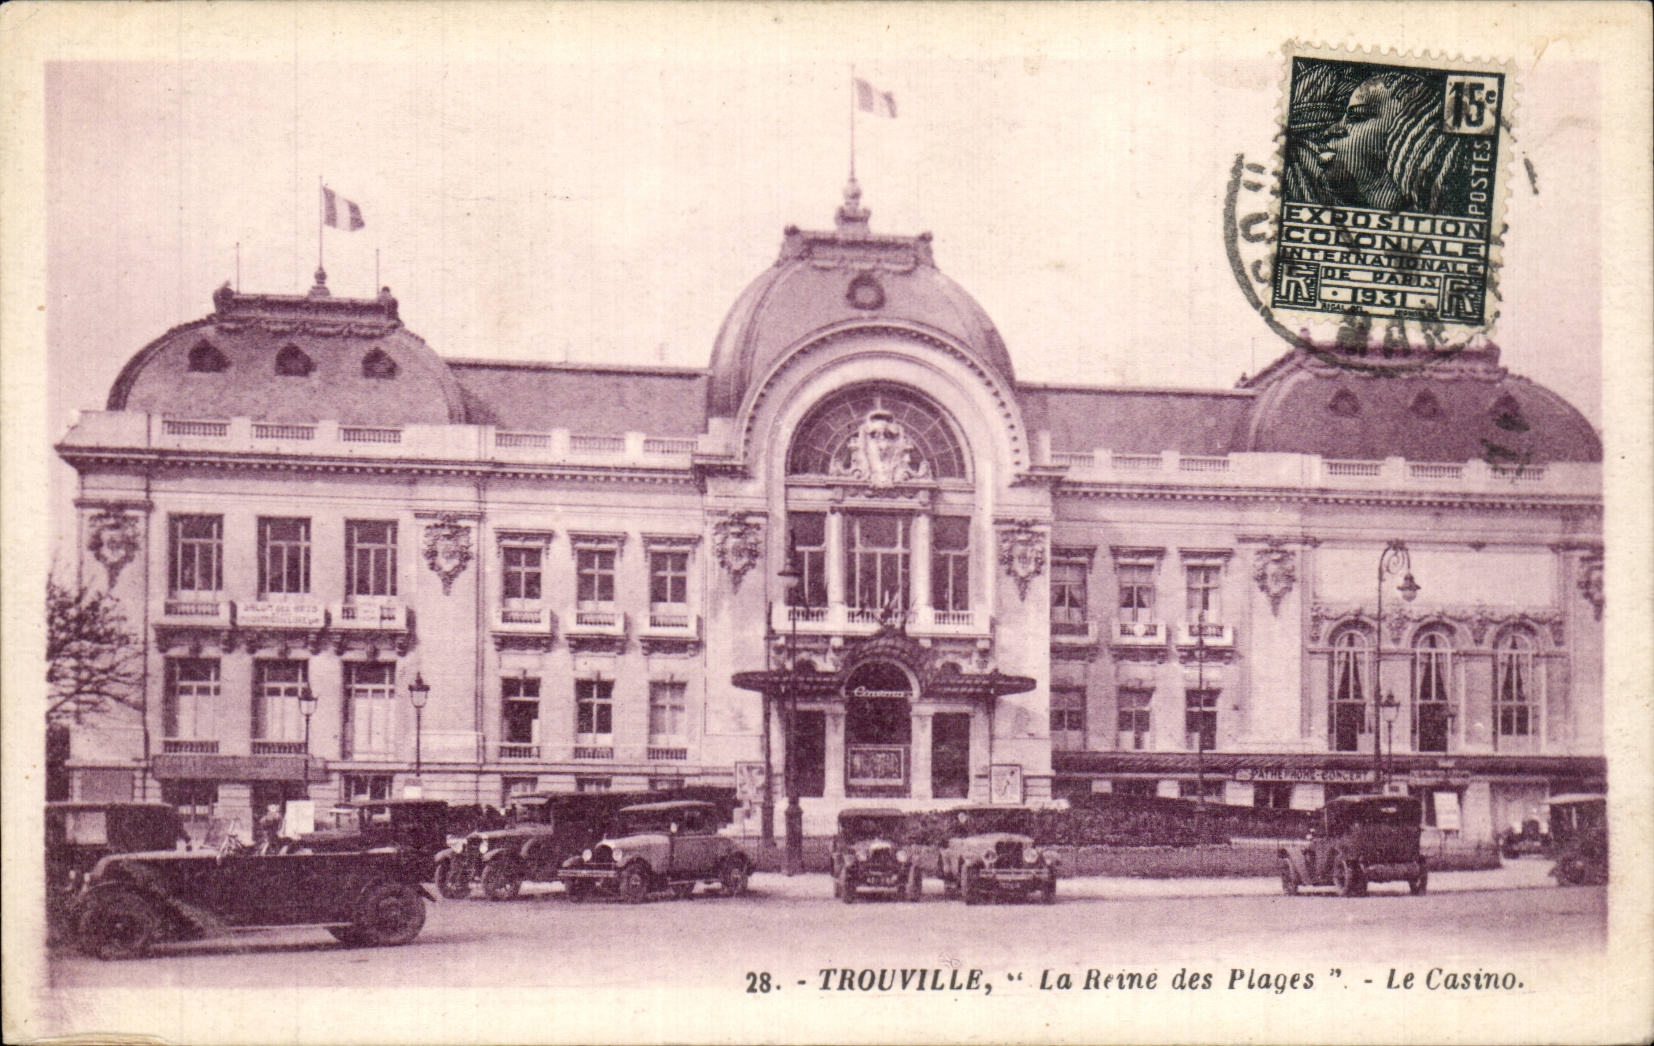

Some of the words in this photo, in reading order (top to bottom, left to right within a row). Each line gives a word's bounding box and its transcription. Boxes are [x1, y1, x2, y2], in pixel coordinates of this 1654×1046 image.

[1468, 139, 1492, 216] POSTES
[1286, 205, 1484, 239] EXPOSITION
[1284, 227, 1482, 257] COLONIALE
[1281, 247, 1483, 275] INTERNATIONALE
[1322, 266, 1351, 281] DE
[1372, 271, 1437, 288] PARIS
[1352, 287, 1407, 308] 1931
